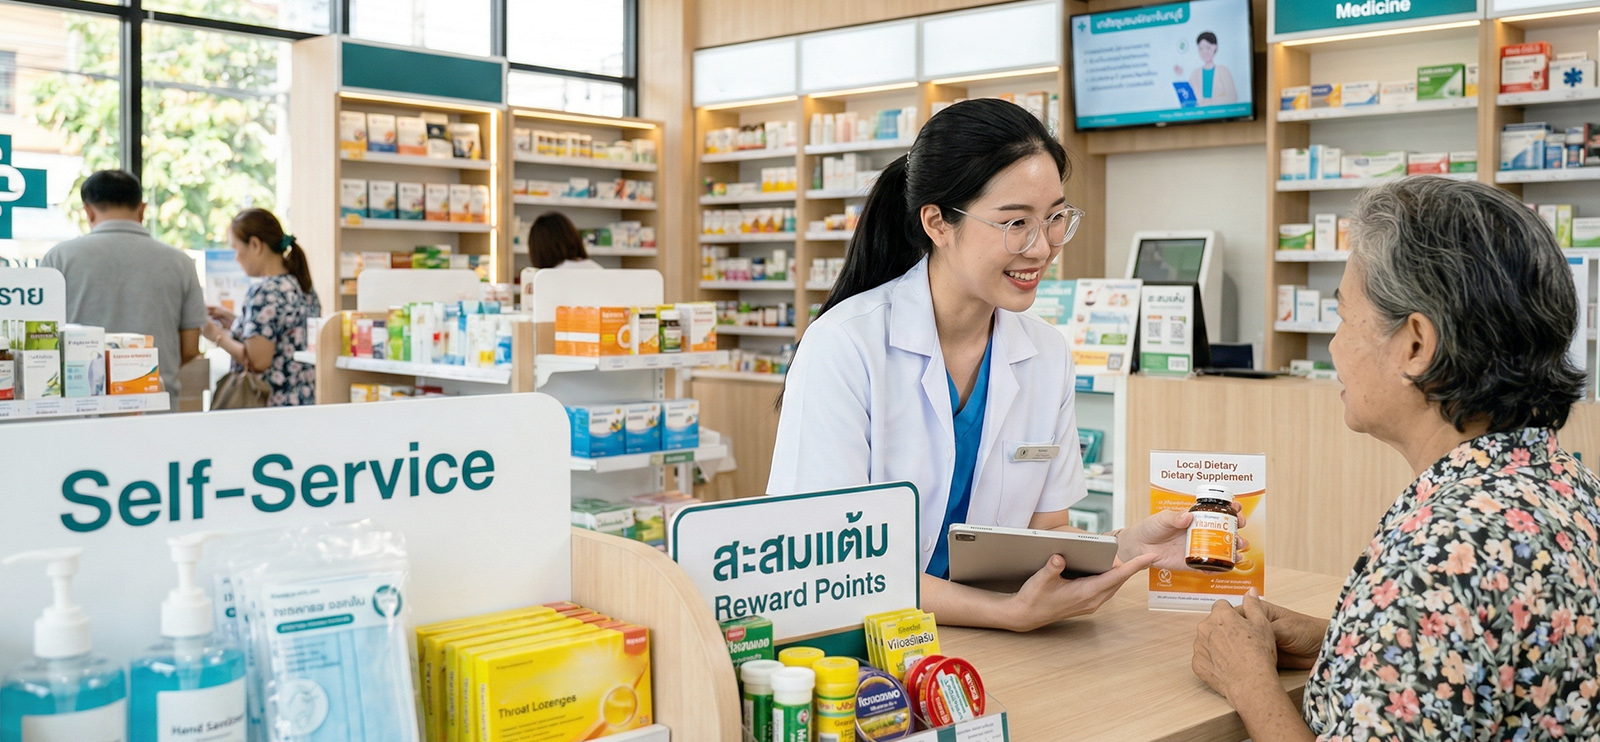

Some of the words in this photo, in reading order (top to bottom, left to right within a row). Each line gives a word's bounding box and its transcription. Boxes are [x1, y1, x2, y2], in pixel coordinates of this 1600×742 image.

[1336, 0, 1411, 19] Medicine
[1176, 459, 1202, 470] Local
[1204, 460, 1238, 472] Dietary
[1161, 470, 1194, 482] Dietary
[1195, 471, 1253, 482] Supplement
[60, 442, 496, 533] Self-Service
[1222, 522, 1229, 531] C
[713, 511, 889, 582] สะสมแต้ม
[714, 582, 807, 621] Reward
[815, 572, 886, 604] Points
[498, 705, 530, 719] Throat
